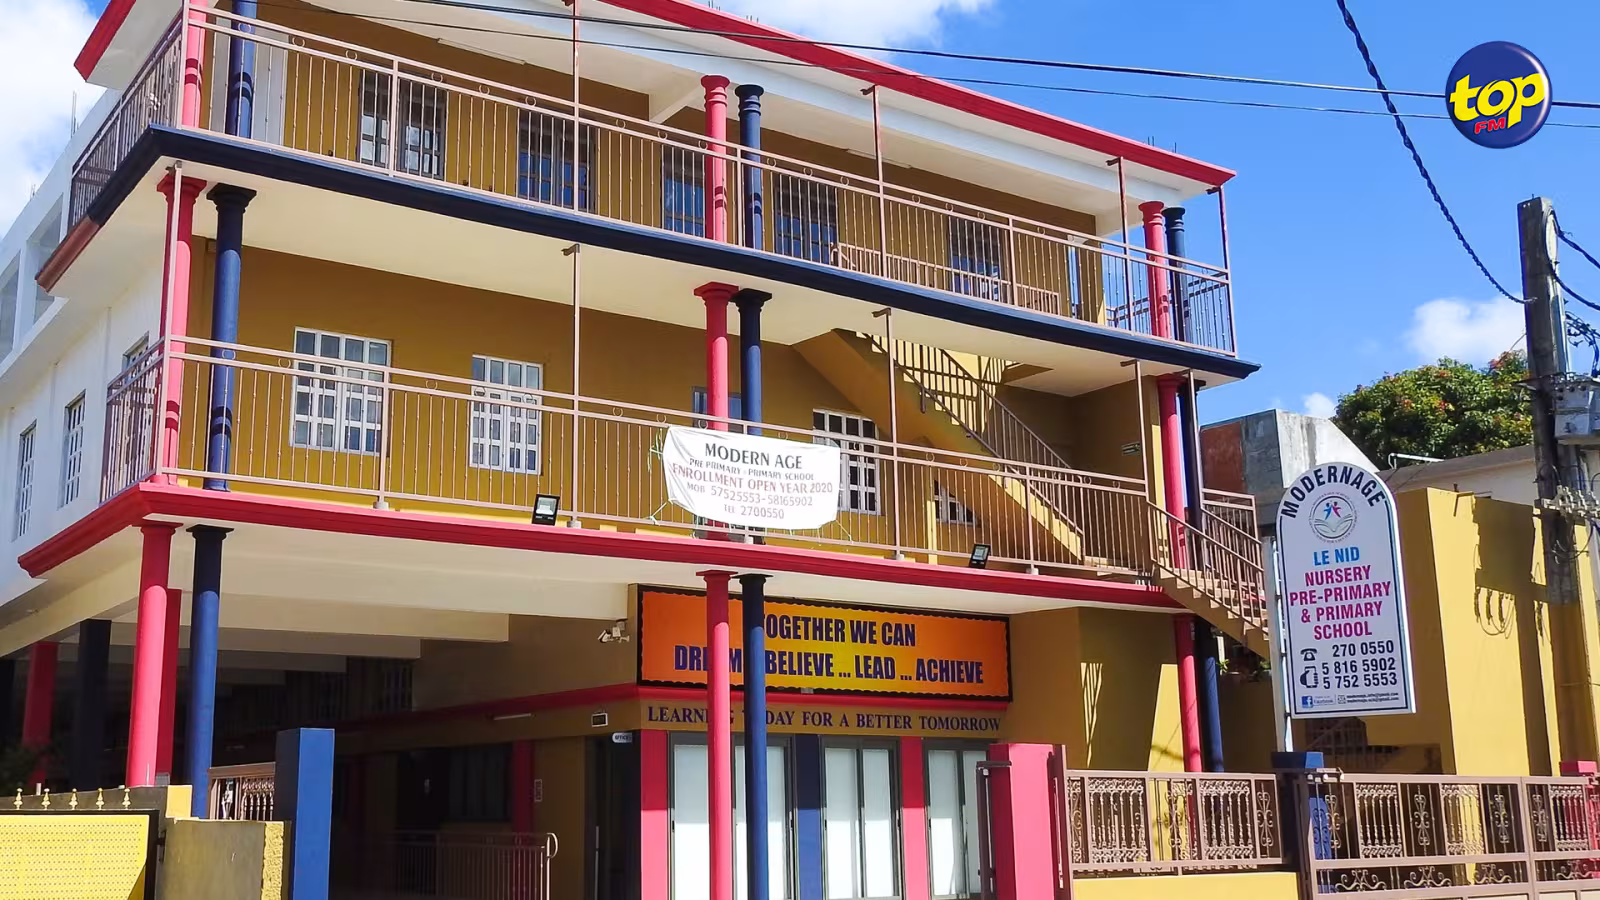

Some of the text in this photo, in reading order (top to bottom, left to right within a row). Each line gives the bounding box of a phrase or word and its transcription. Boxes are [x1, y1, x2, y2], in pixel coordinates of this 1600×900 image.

[705, 443, 803, 470] MODERN AGE
[672, 463, 833, 494] ENROLLMENT OPEN YEAR 2020
[689, 458, 703, 468] PRE
[705, 461, 742, 475] PRIMARY
[748, 468, 782, 480] PRIMARY
[785, 473, 814, 481] SCHOOL
[686, 482, 706, 493] MOB
[1281, 465, 1386, 519] MODERNAGE
[724, 504, 784, 519] TEL 2700550
[1313, 546, 1360, 566] LE NID
[1305, 564, 1371, 587] NURSERY
[1289, 581, 1391, 606] PRE-PRIMARY
[1301, 600, 1383, 623] & PRIMARY
[764, 614, 916, 647] OGETHER WE CAN
[1314, 620, 1372, 640] SCHOOL
[1332, 640, 1394, 657] 270 0550
[765, 650, 834, 677] BELIEVE
[855, 655, 896, 680] LEAD
[915, 658, 984, 684] ACHIEVE
[1322, 657, 1396, 675] 5 816 5902
[1323, 672, 1397, 689] 5 752 5553
[802, 711, 833, 726] FOR
[839, 714, 850, 728] A
[856, 713, 912, 729] BETTER
[919, 716, 1000, 731] TOMORROW
